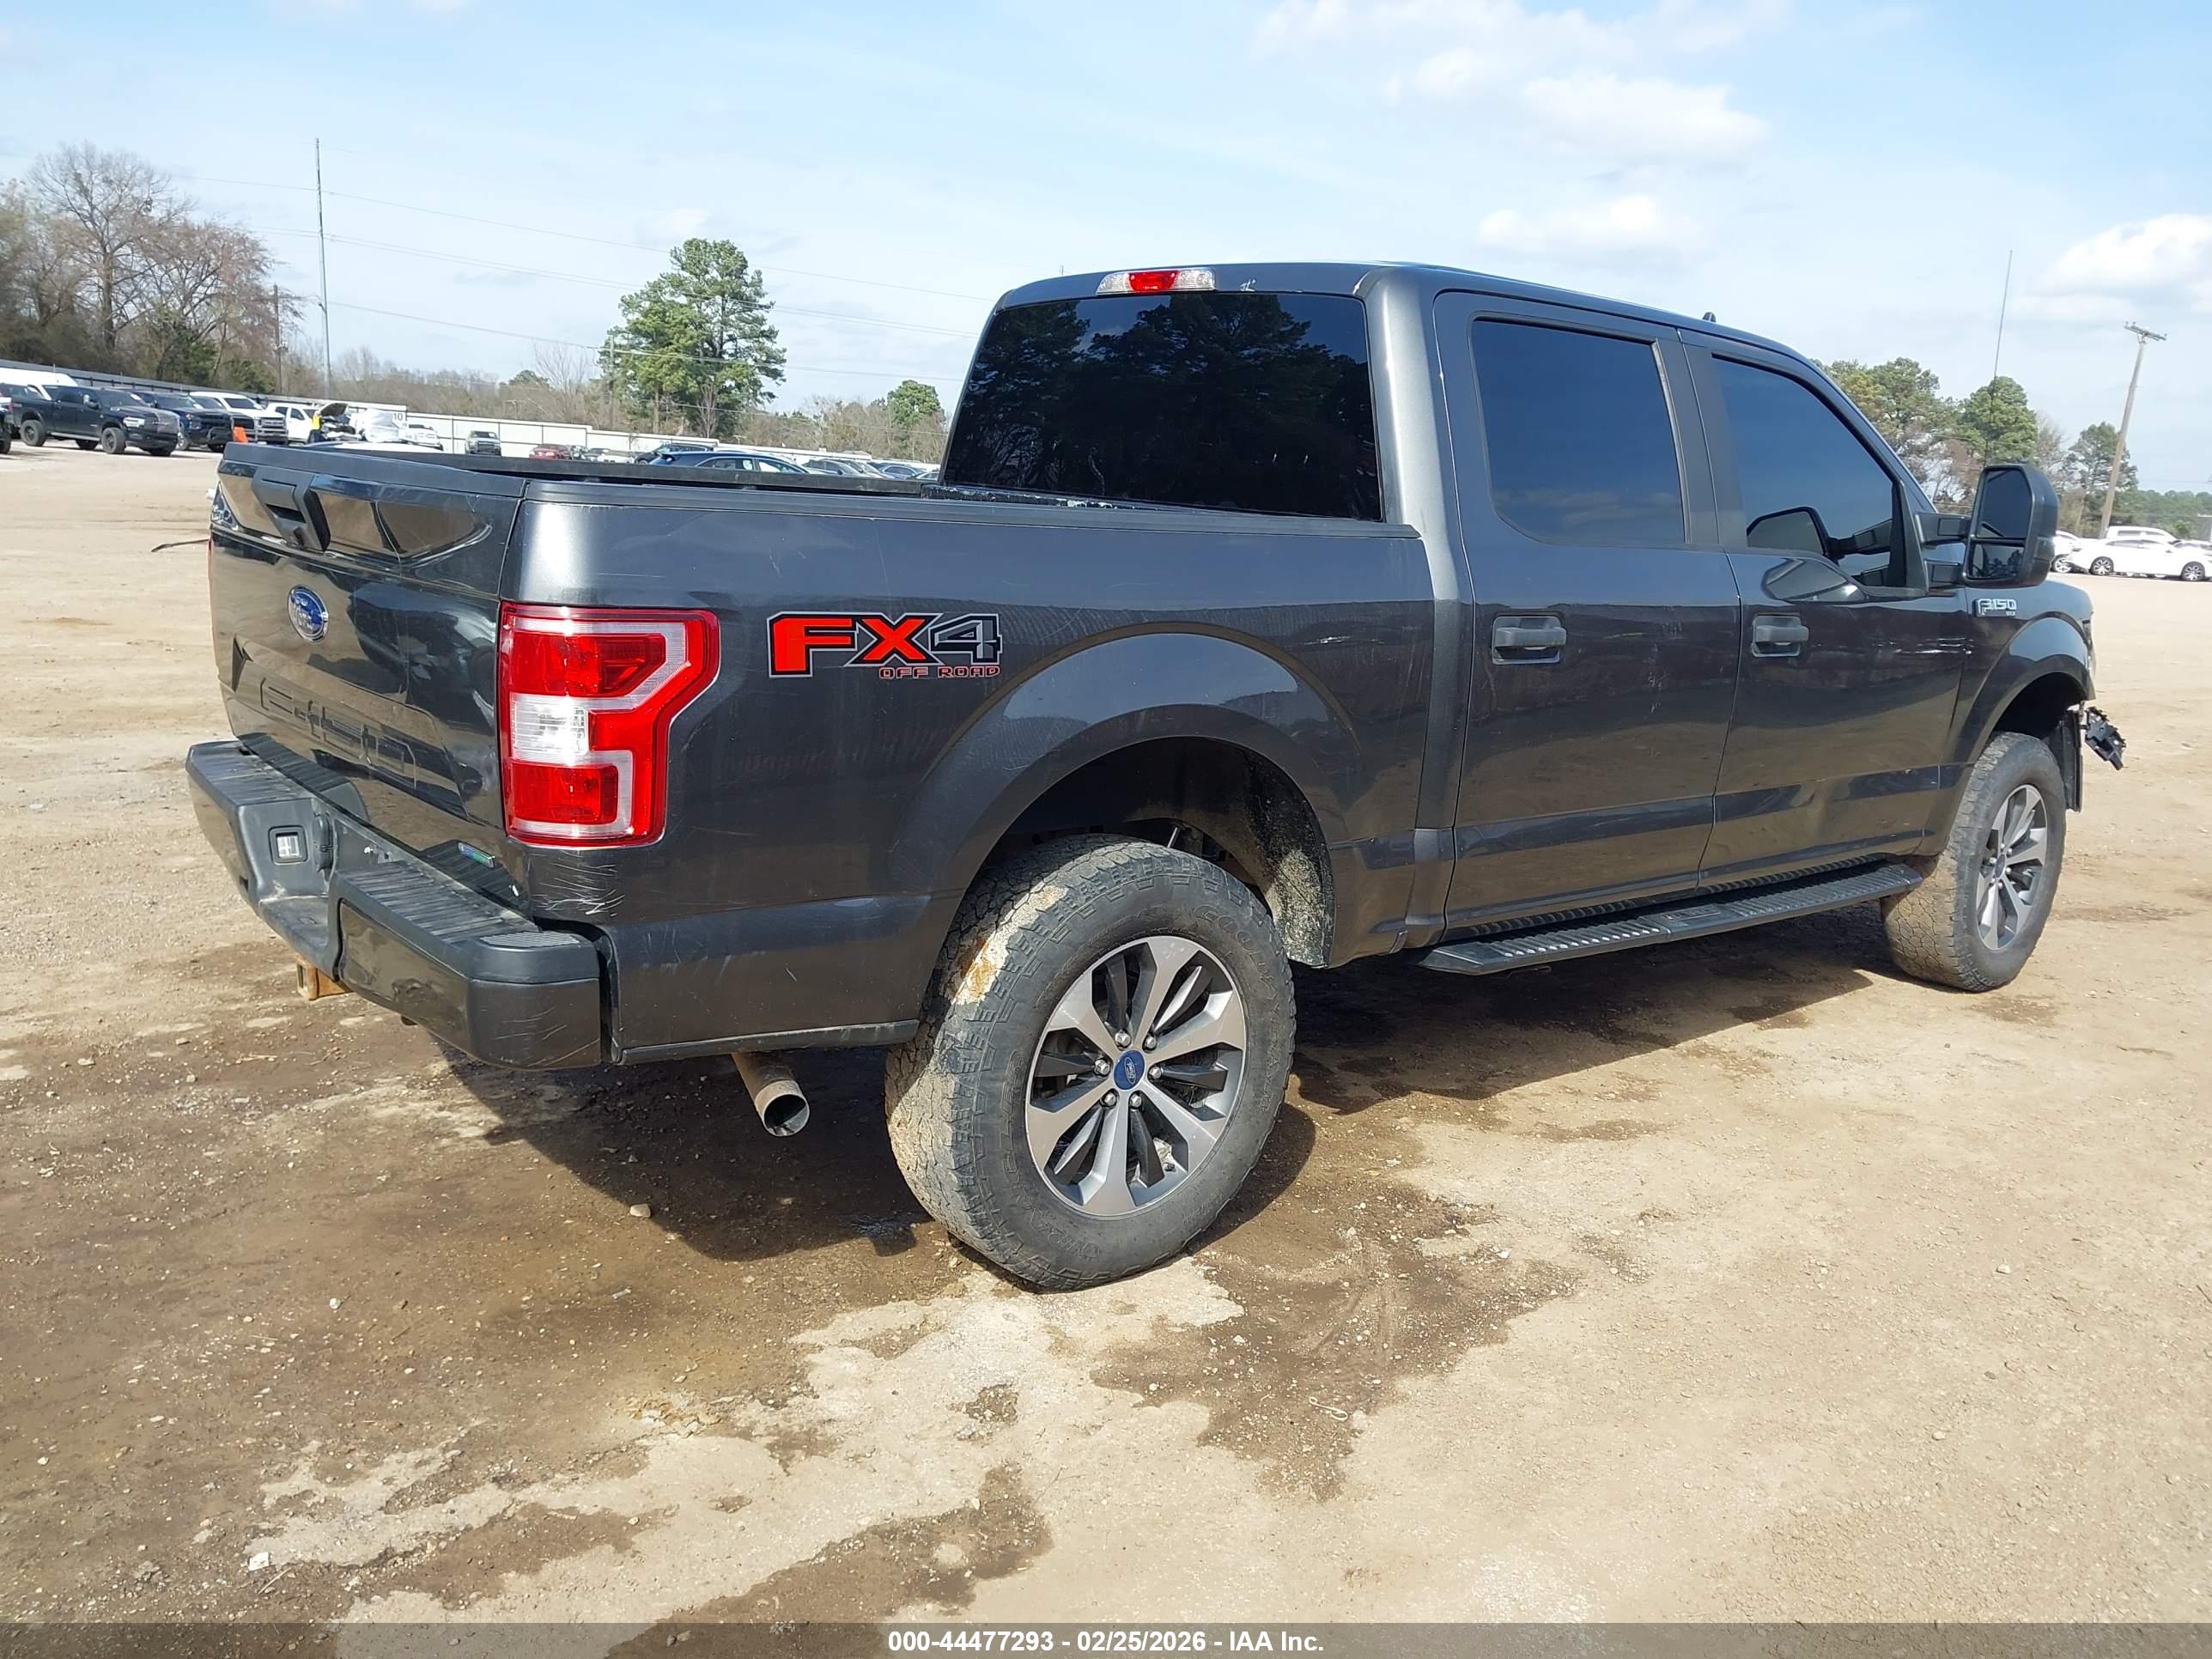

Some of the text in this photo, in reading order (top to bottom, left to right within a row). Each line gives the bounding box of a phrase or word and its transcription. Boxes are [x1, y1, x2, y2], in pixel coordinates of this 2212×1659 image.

[393, 412, 404, 421] 10
[767, 611, 1003, 678] FX4
[878, 665, 1000, 680] OFF ROAD
